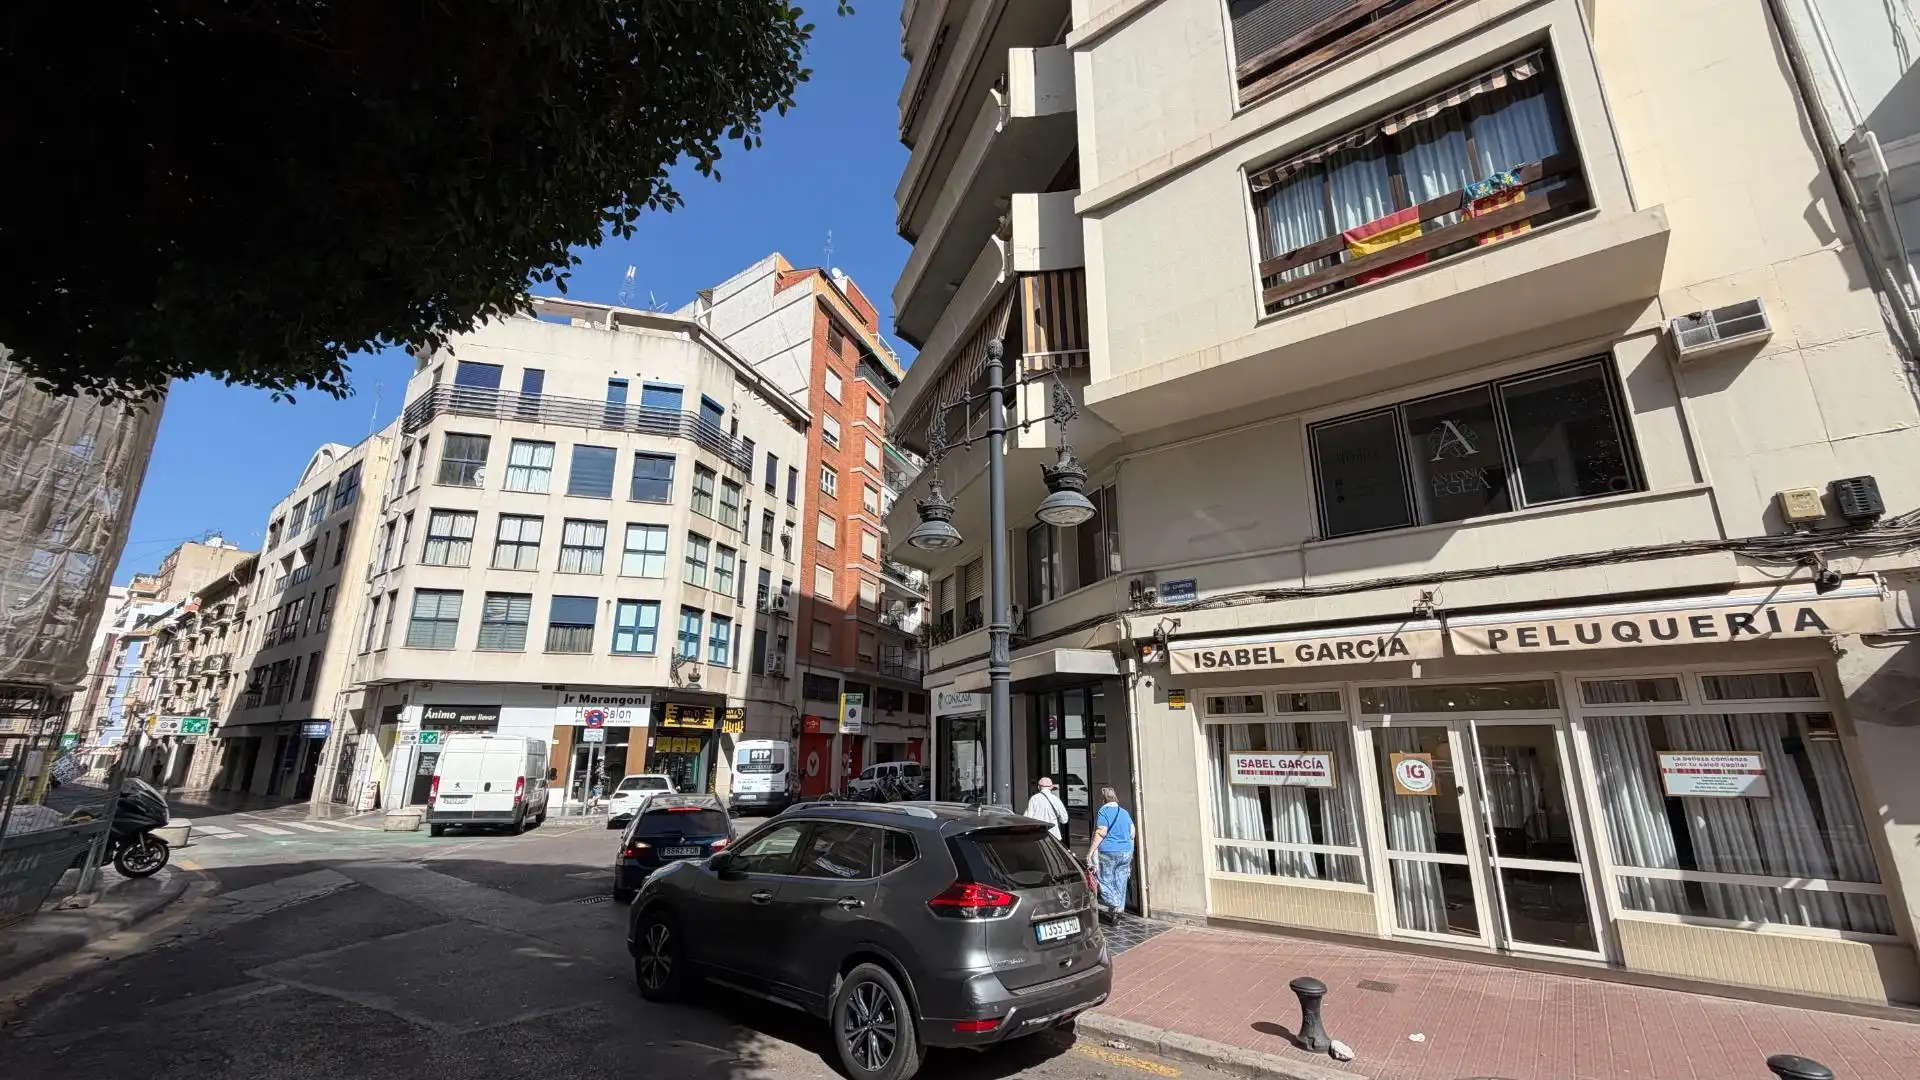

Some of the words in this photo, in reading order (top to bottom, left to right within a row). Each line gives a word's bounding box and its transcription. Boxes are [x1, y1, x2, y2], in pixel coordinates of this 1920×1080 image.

[1430, 421, 1480, 461] A
[1434, 476, 1492, 497] EGEA
[1487, 607, 1831, 650] PELUQUERÍA
[1194, 646, 1285, 669] ISABEL
[1295, 636, 1410, 663] GARCÍA
[564, 693, 575, 704] Jr
[580, 694, 647, 706] Marangoni
[424, 707, 457, 719] Ánimo
[603, 706, 632, 719] Salon
[1236, 759, 1276, 768] ISABEL
[1279, 757, 1324, 769] GARCÍA
[1405, 764, 1426, 779] IG
[1044, 922, 1063, 937] 1355
